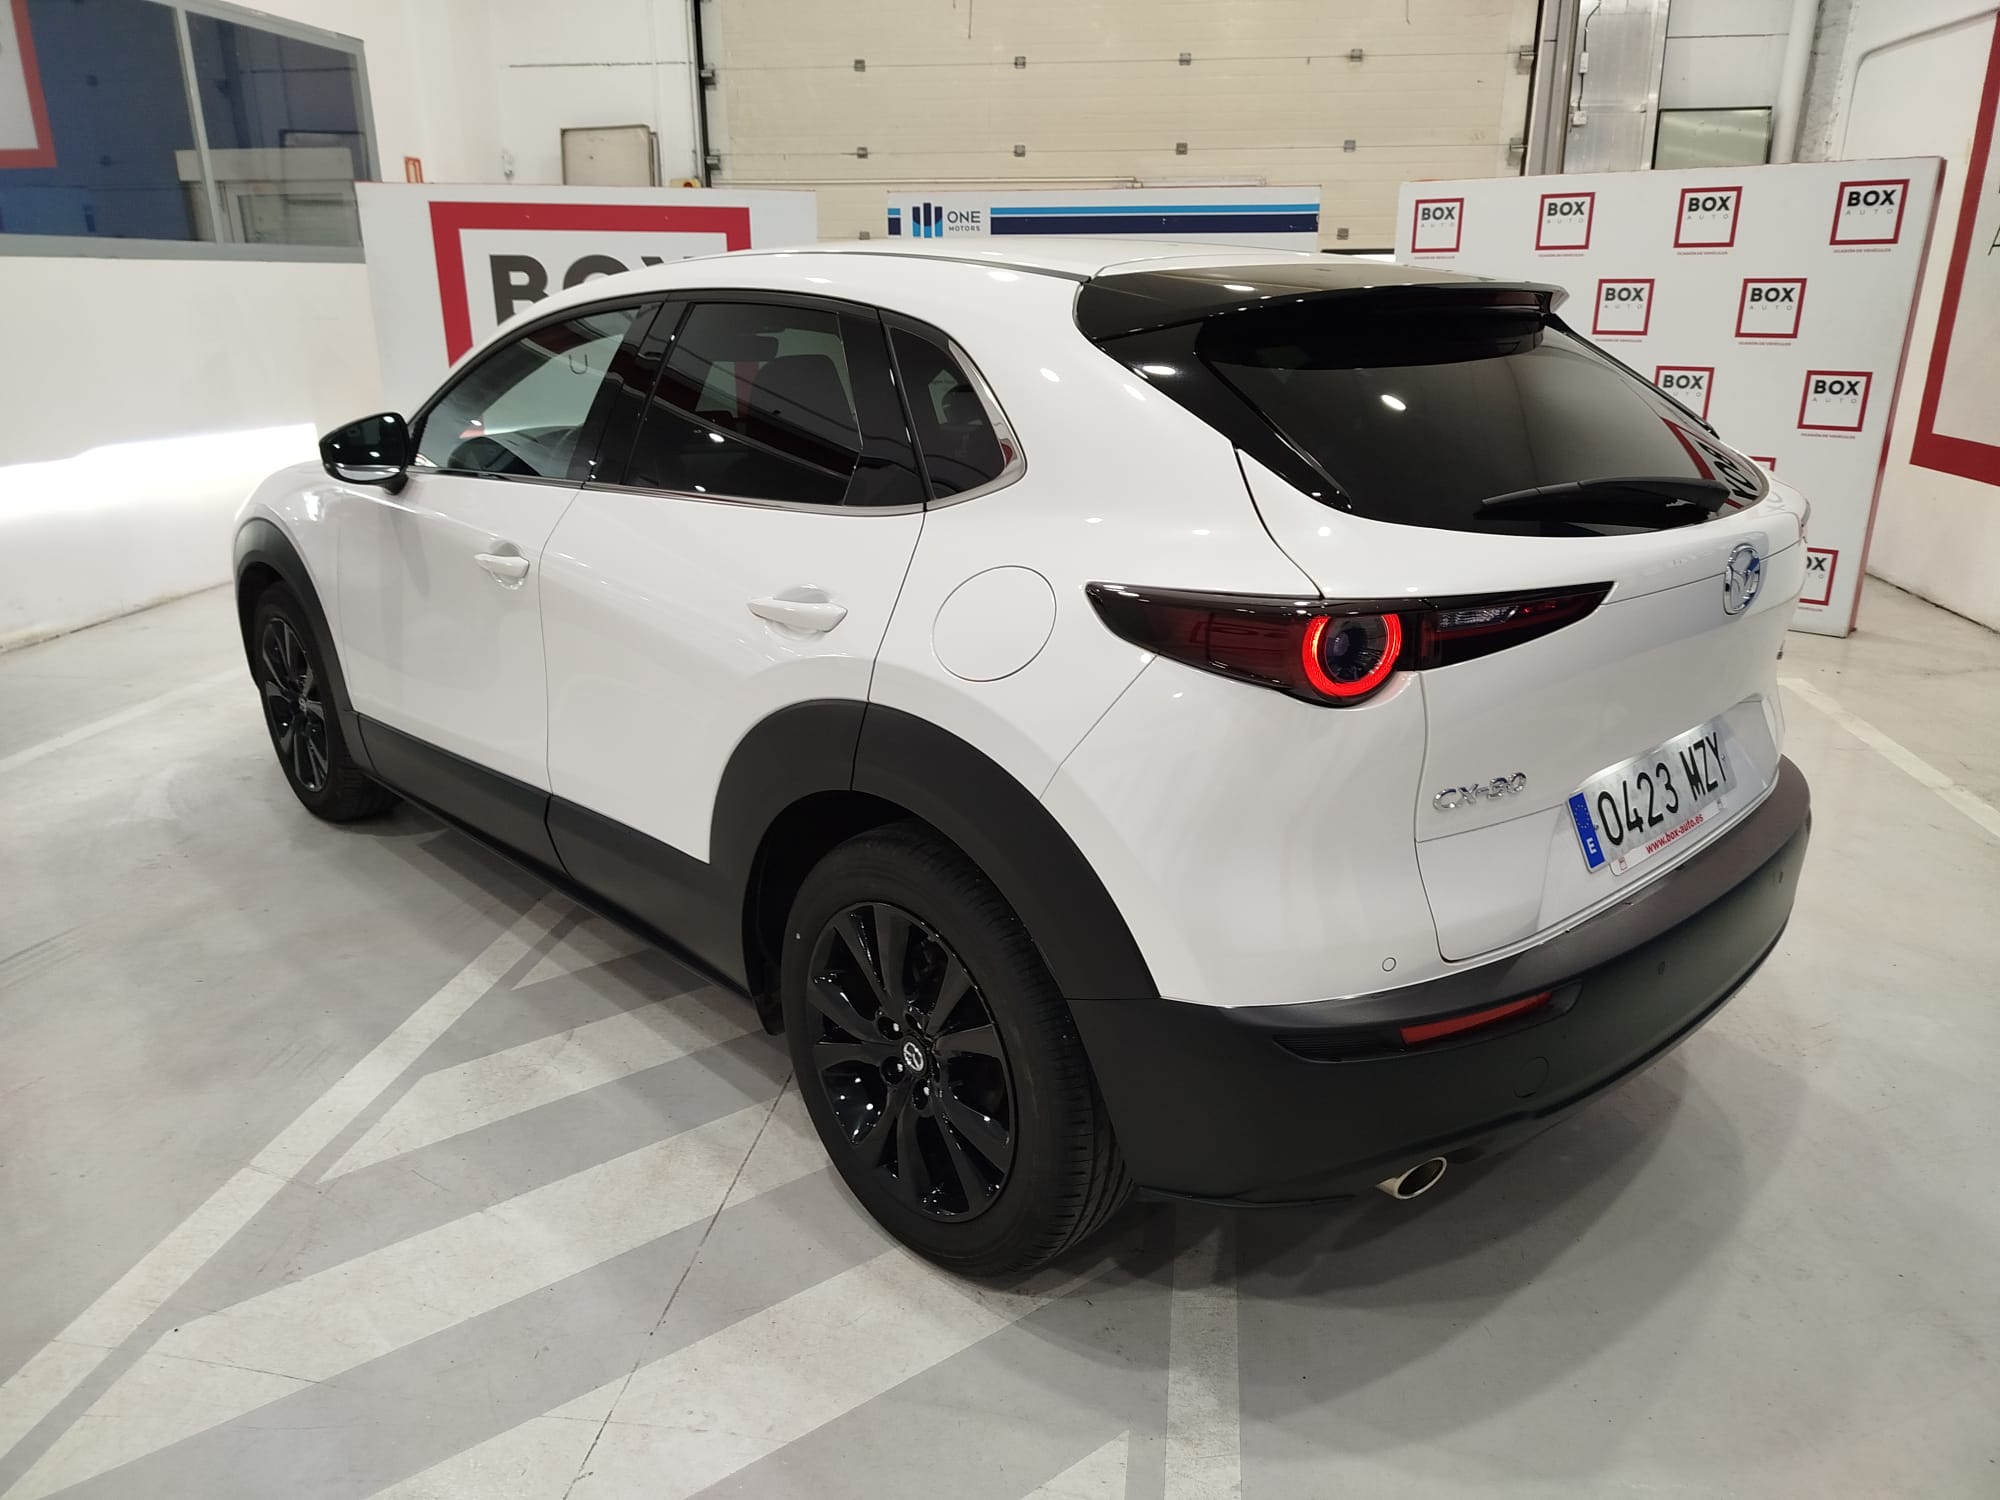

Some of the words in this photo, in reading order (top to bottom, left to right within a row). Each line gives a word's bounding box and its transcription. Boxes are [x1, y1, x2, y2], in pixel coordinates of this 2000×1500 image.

[1687, 196, 1731, 212] BOX
[1847, 189, 1896, 207] BOX
[947, 210, 981, 224] ONE
[1421, 206, 1455, 221] BOX
[1547, 201, 1586, 217] BOX
[1845, 208, 1894, 216] AUTO
[1604, 287, 1644, 301] BOX
[1750, 287, 1795, 302] BOX
[1662, 374, 1704, 389] BOX
[1813, 379, 1860, 396] BOX
[1432, 772, 1527, 811] CX-30
[1597, 762, 1679, 846] 0423
[1679, 731, 1727, 801] MZY
[1645, 814, 1704, 855] www.box-auto.es
[1585, 837, 1597, 855] E
